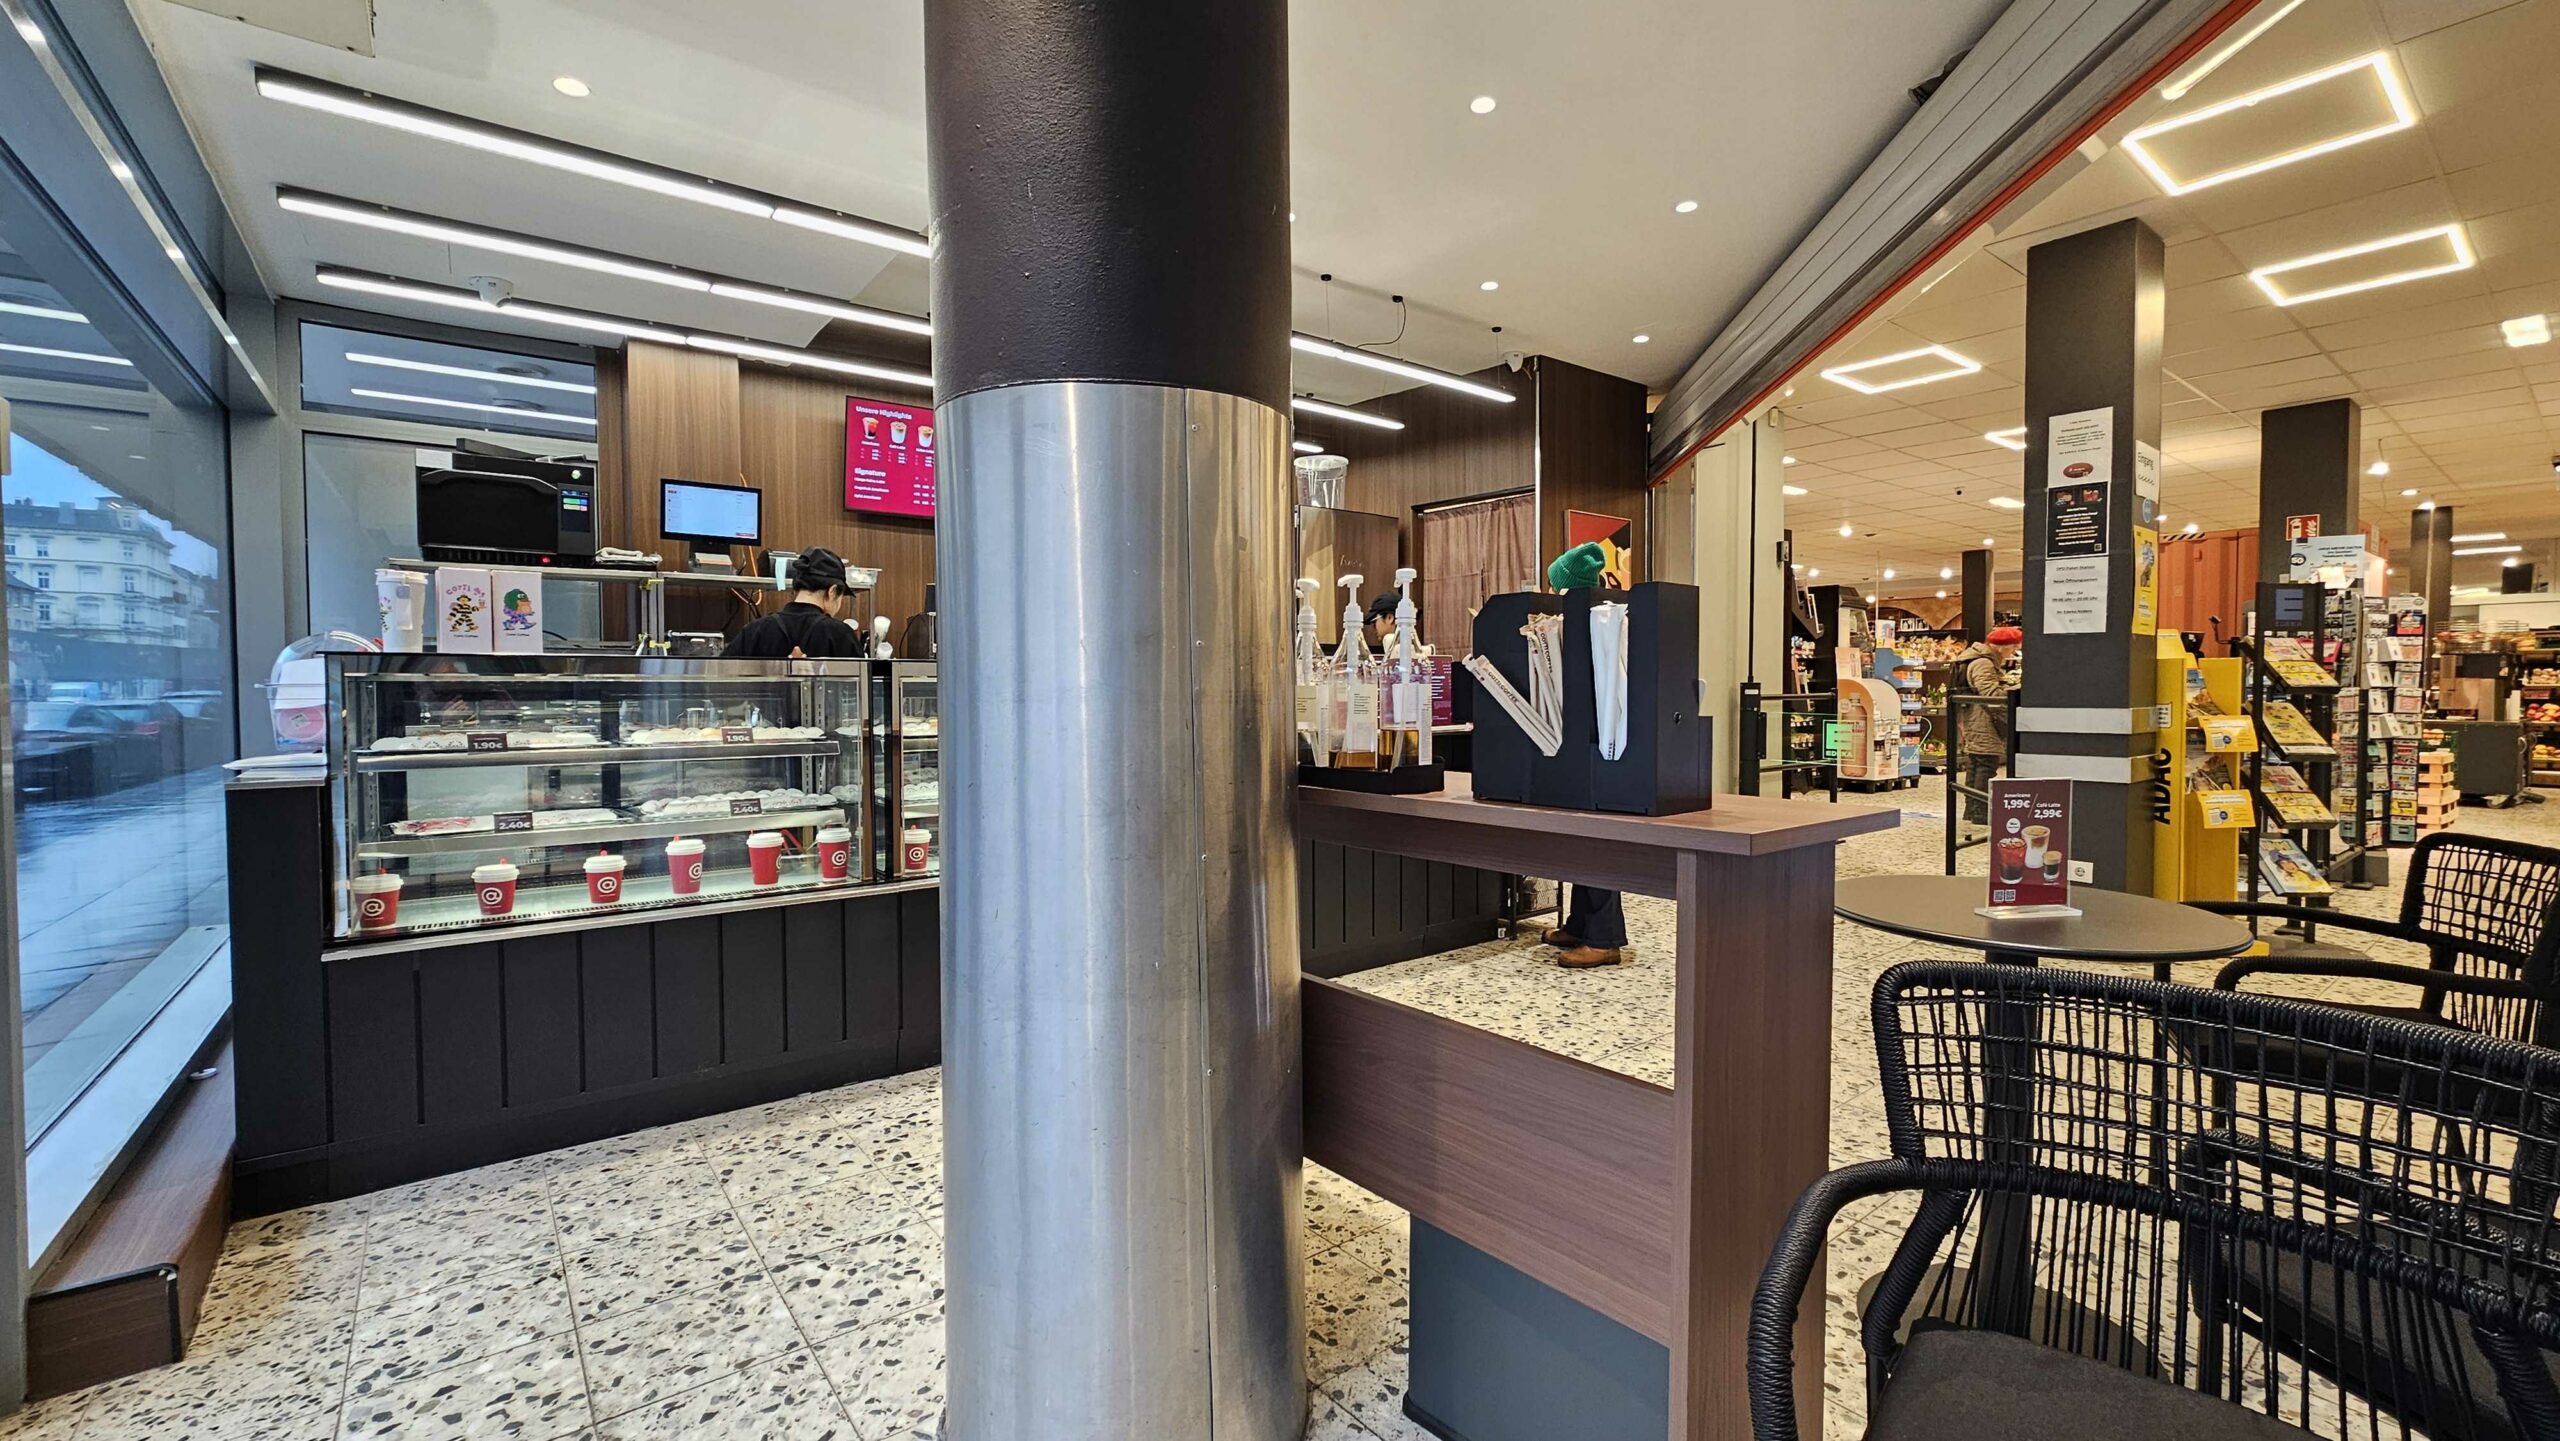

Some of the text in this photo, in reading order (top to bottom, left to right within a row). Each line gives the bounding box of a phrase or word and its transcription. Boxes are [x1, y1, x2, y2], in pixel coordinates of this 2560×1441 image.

[2151, 748, 2172, 825] ADAC
[2003, 799, 2031, 810] 1,99€
[2034, 809, 2062, 820] 2,99€
